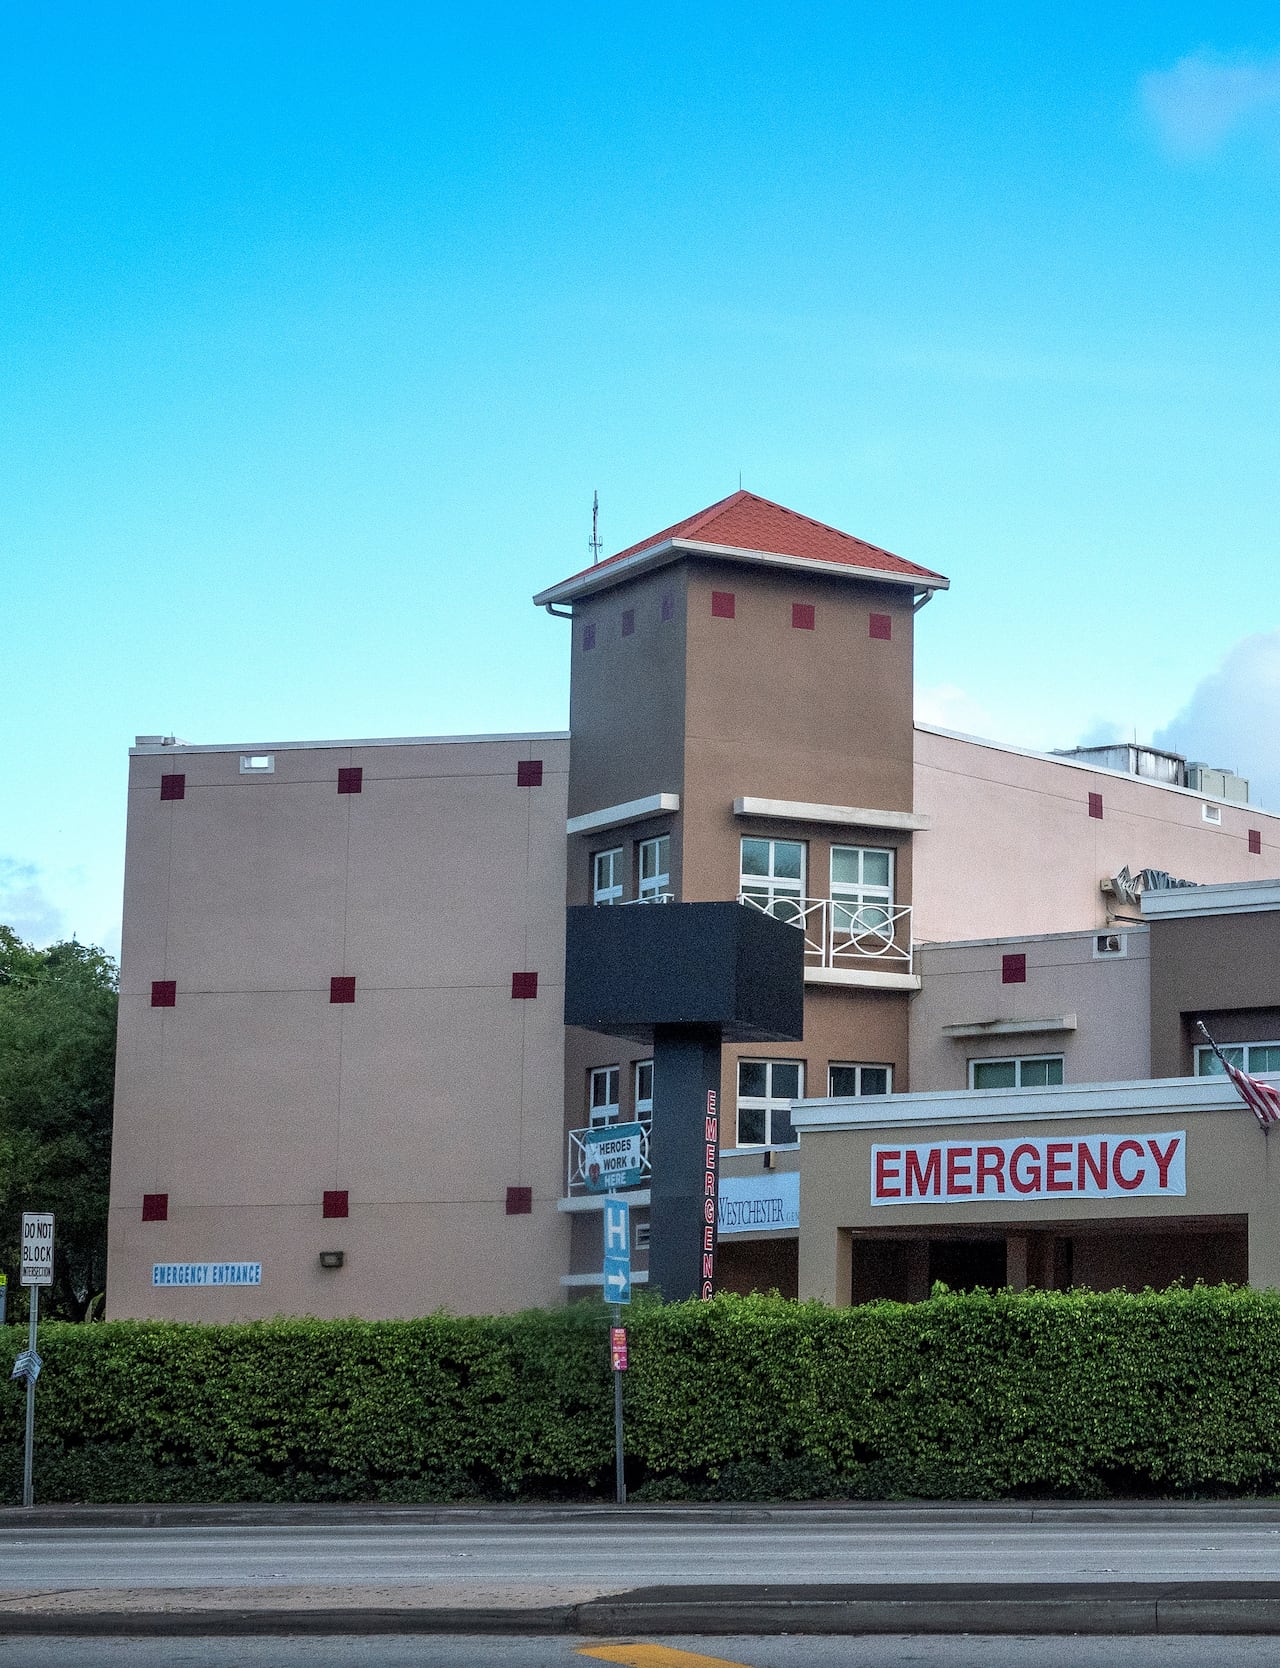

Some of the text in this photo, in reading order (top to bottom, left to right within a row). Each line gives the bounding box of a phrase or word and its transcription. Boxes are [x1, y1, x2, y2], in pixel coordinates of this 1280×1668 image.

[599, 1138, 632, 1156] HEROES
[603, 1156, 628, 1171] WORK
[876, 1138, 1181, 1198] EMERGENCY
[604, 1172, 627, 1188] HERE
[702, 1089, 716, 1302] EMERGENC
[24, 1221, 52, 1239] DO NOT
[607, 1207, 626, 1250] H
[23, 1245, 52, 1262] BLOCK
[154, 1265, 260, 1284] EMERGENCY ENTRANCE
